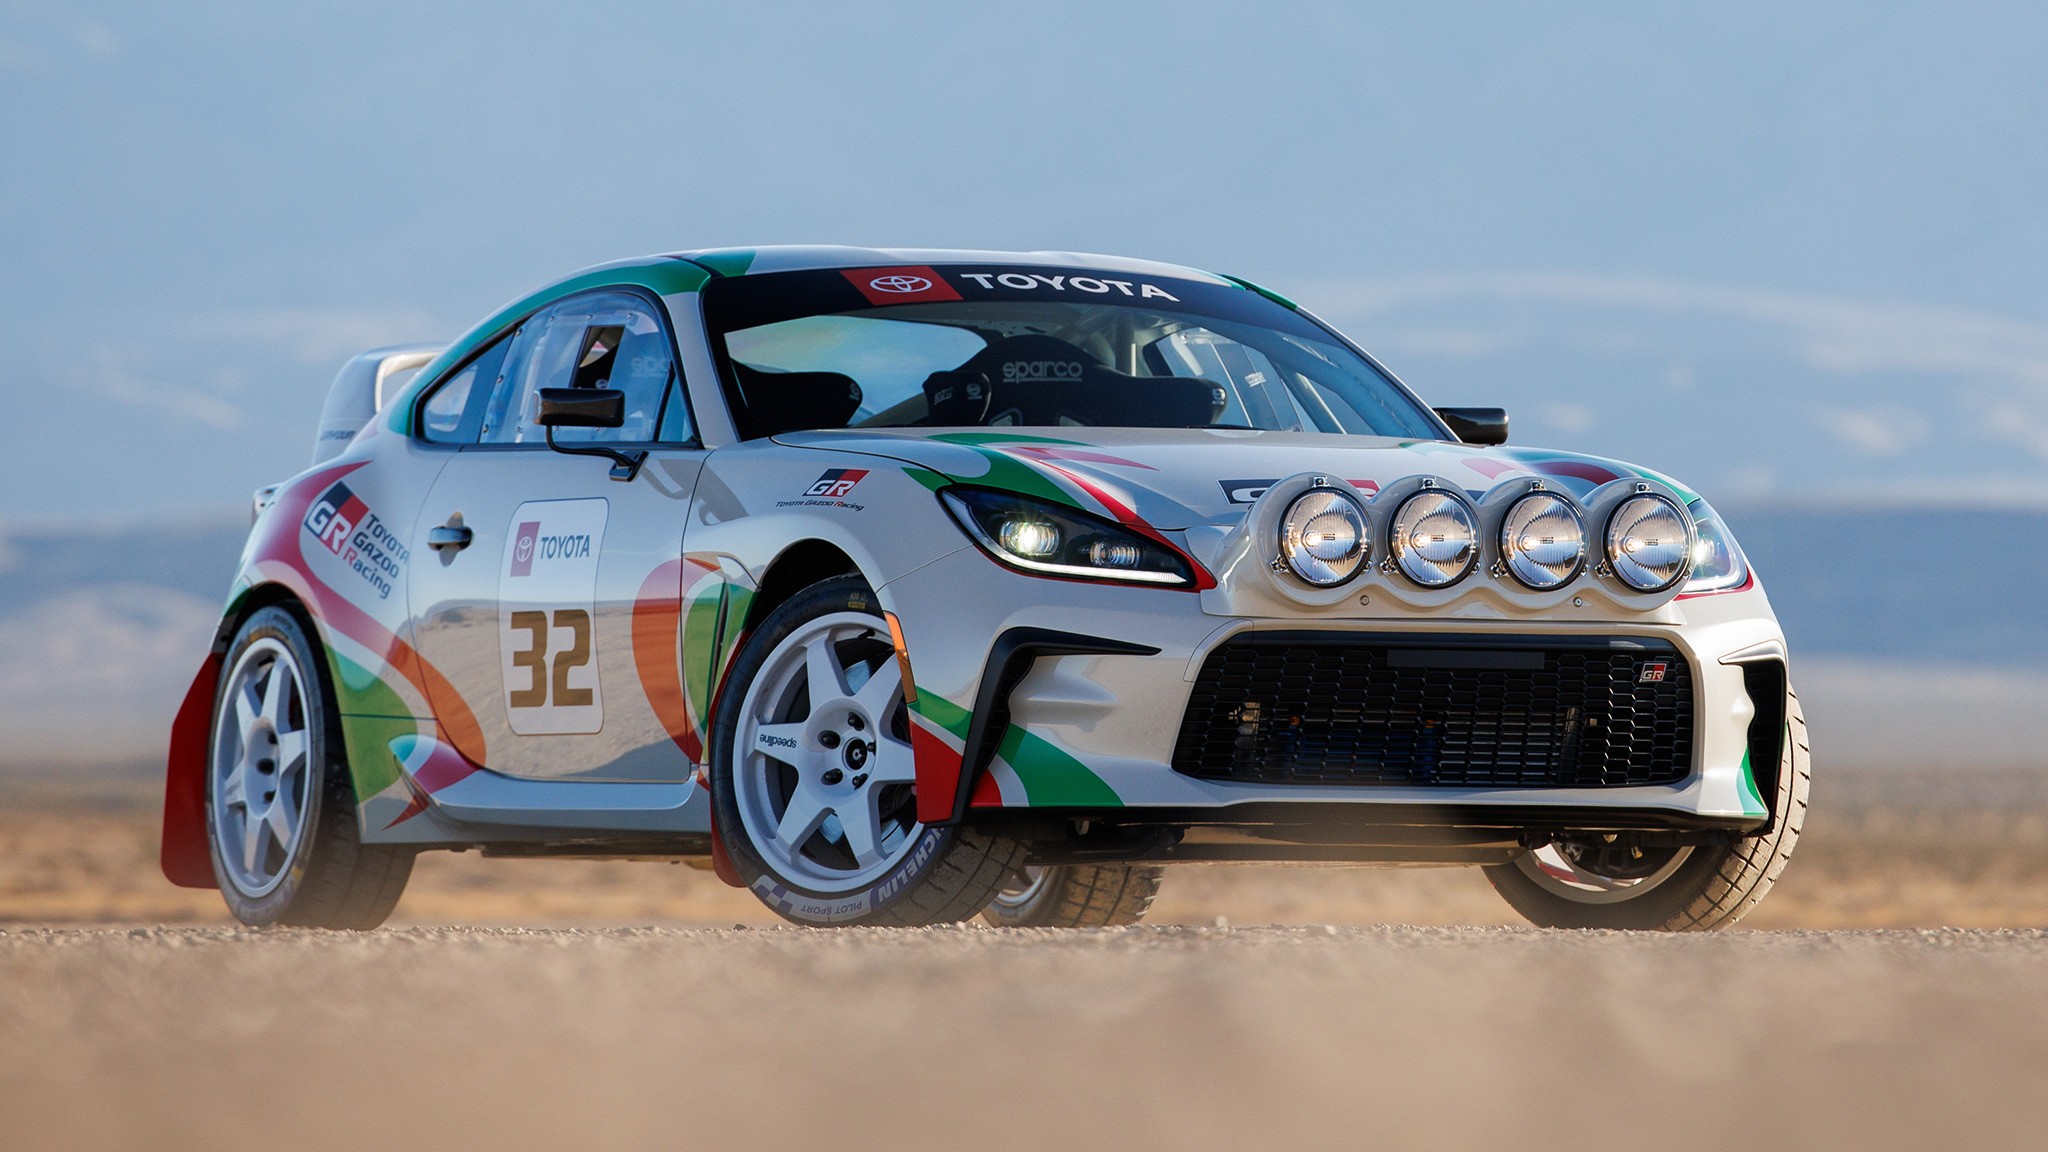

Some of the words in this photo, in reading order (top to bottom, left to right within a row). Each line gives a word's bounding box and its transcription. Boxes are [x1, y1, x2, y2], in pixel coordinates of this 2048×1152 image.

[960, 273, 1180, 303] TOYOTA
[1002, 361, 1083, 384] sparco
[806, 479, 856, 496] GR
[804, 500, 834, 508] GAZOO
[834, 501, 864, 512] Racing
[306, 500, 353, 553] GR
[365, 513, 410, 564] TOYOTA
[352, 532, 400, 578] GAZOO
[540, 535, 590, 559] TOYOTA
[343, 546, 392, 600] Racing
[510, 609, 593, 708] 32
[1642, 670, 1663, 680] GR
[759, 733, 797, 748] speedline
[878, 827, 945, 903] ICHELIN
[801, 904, 832, 915] SPORT
[834, 901, 862, 914] PILOT
